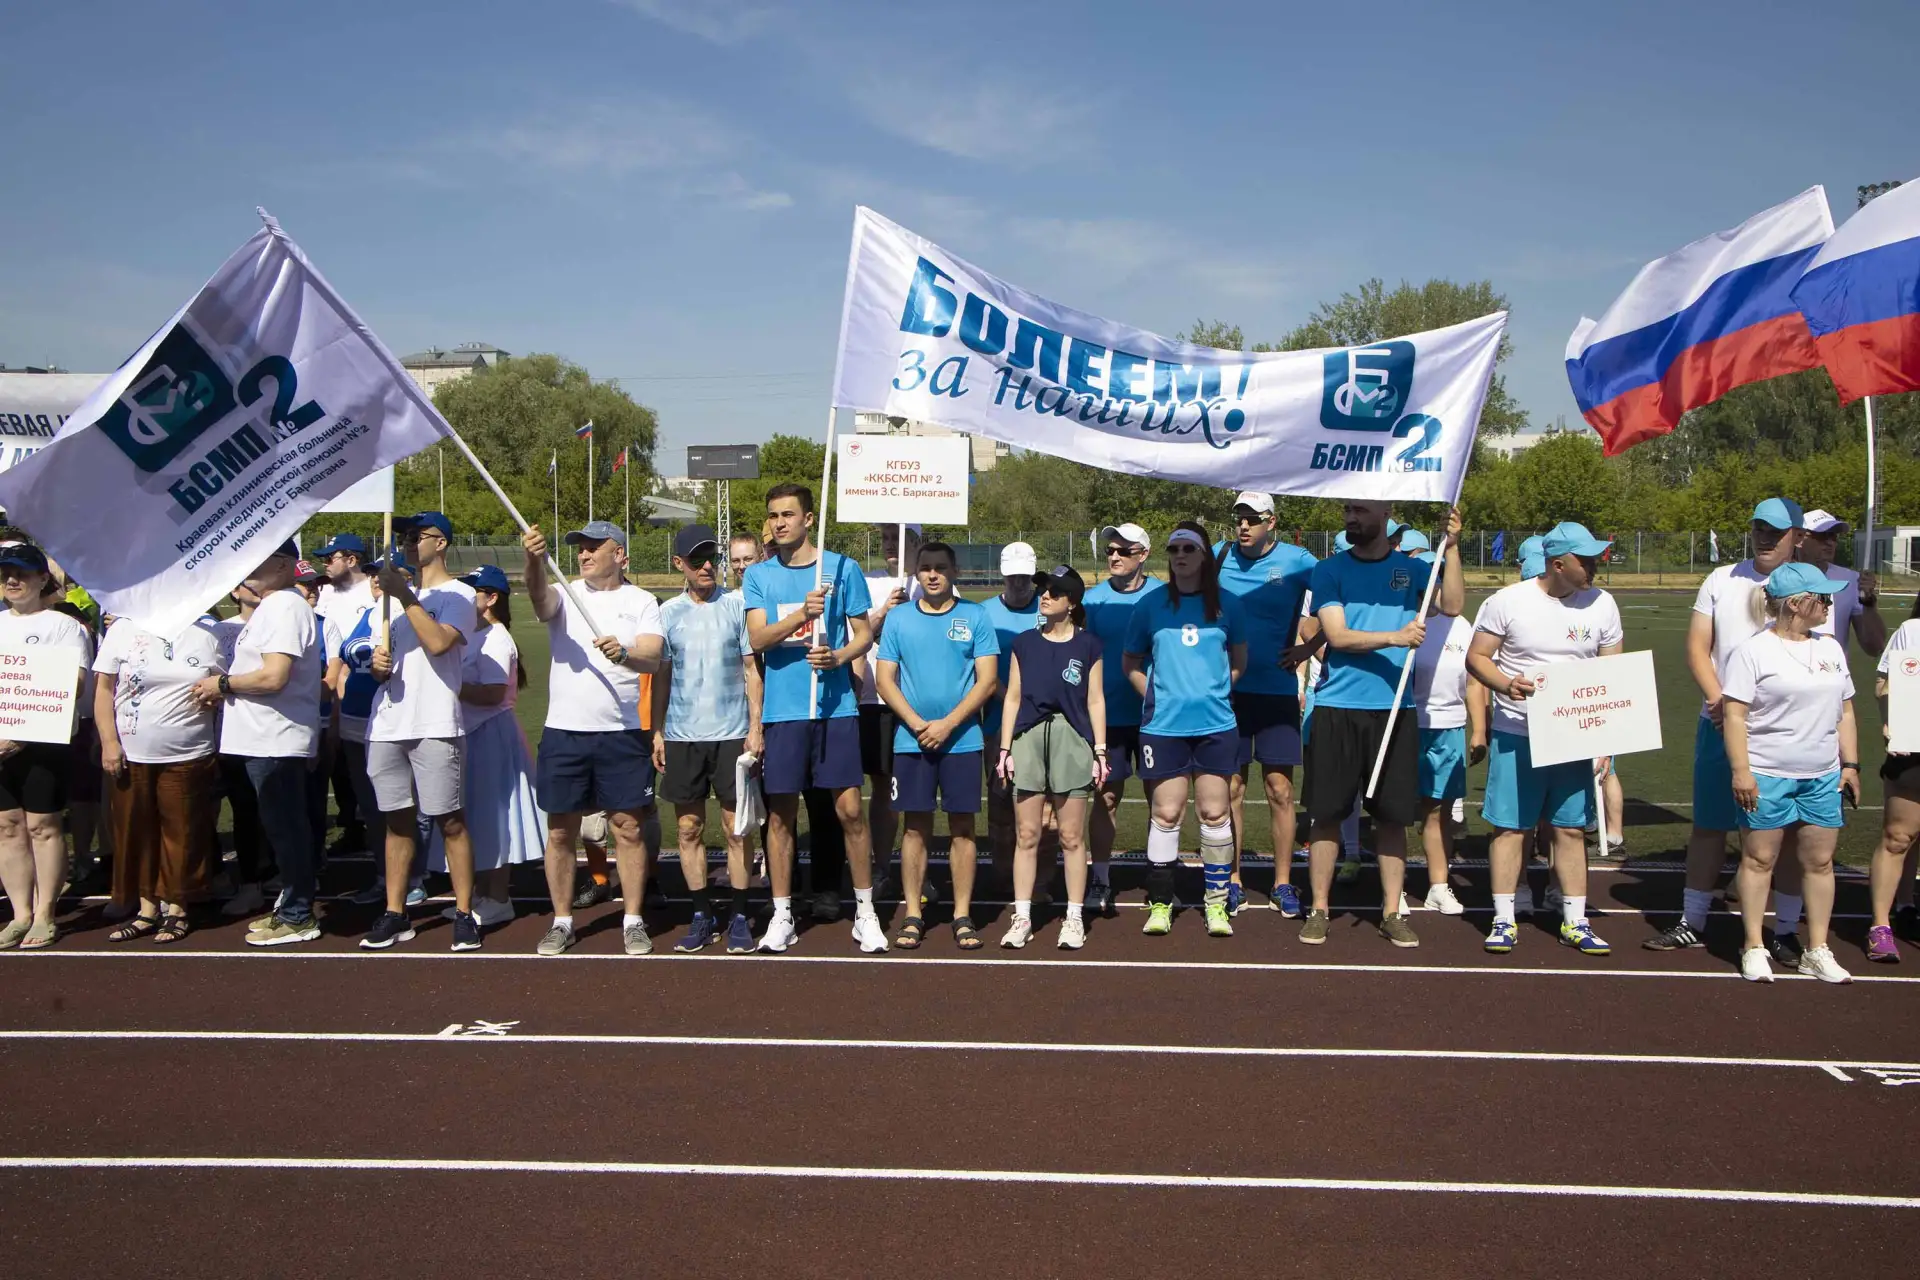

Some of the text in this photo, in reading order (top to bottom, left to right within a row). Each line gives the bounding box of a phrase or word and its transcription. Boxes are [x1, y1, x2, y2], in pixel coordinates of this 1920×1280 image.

[899, 256, 1252, 432] БОЛЕЕМ!
[994, 366, 1231, 449] наших
[167, 423, 271, 516] БСМП
[238, 355, 326, 444] 2
[1310, 443, 1384, 472] БСМП
[1392, 413, 1443, 472] 2
[886, 460, 921, 470] КГБУЗ
[175, 415, 353, 553] Краевая клиническая больница
[864, 473, 942, 484] «ККБСМП № 2
[184, 527, 229, 571] скорой
[226, 465, 302, 532] медицинской
[301, 437, 348, 473] помощи
[845, 487, 961, 498] имени З.С. Баркагана»
[230, 458, 348, 553] имени З.С. Баркагана
[1181, 623, 1200, 647] 8
[14, 685, 69, 700] больница
[1572, 685, 1607, 700] КГБУЗ
[1552, 699, 1632, 718] «Кулундинская
[1579, 716, 1607, 730] ЦРБ»
[1143, 745, 1155, 769] 8
[891, 776, 898, 801] 3
